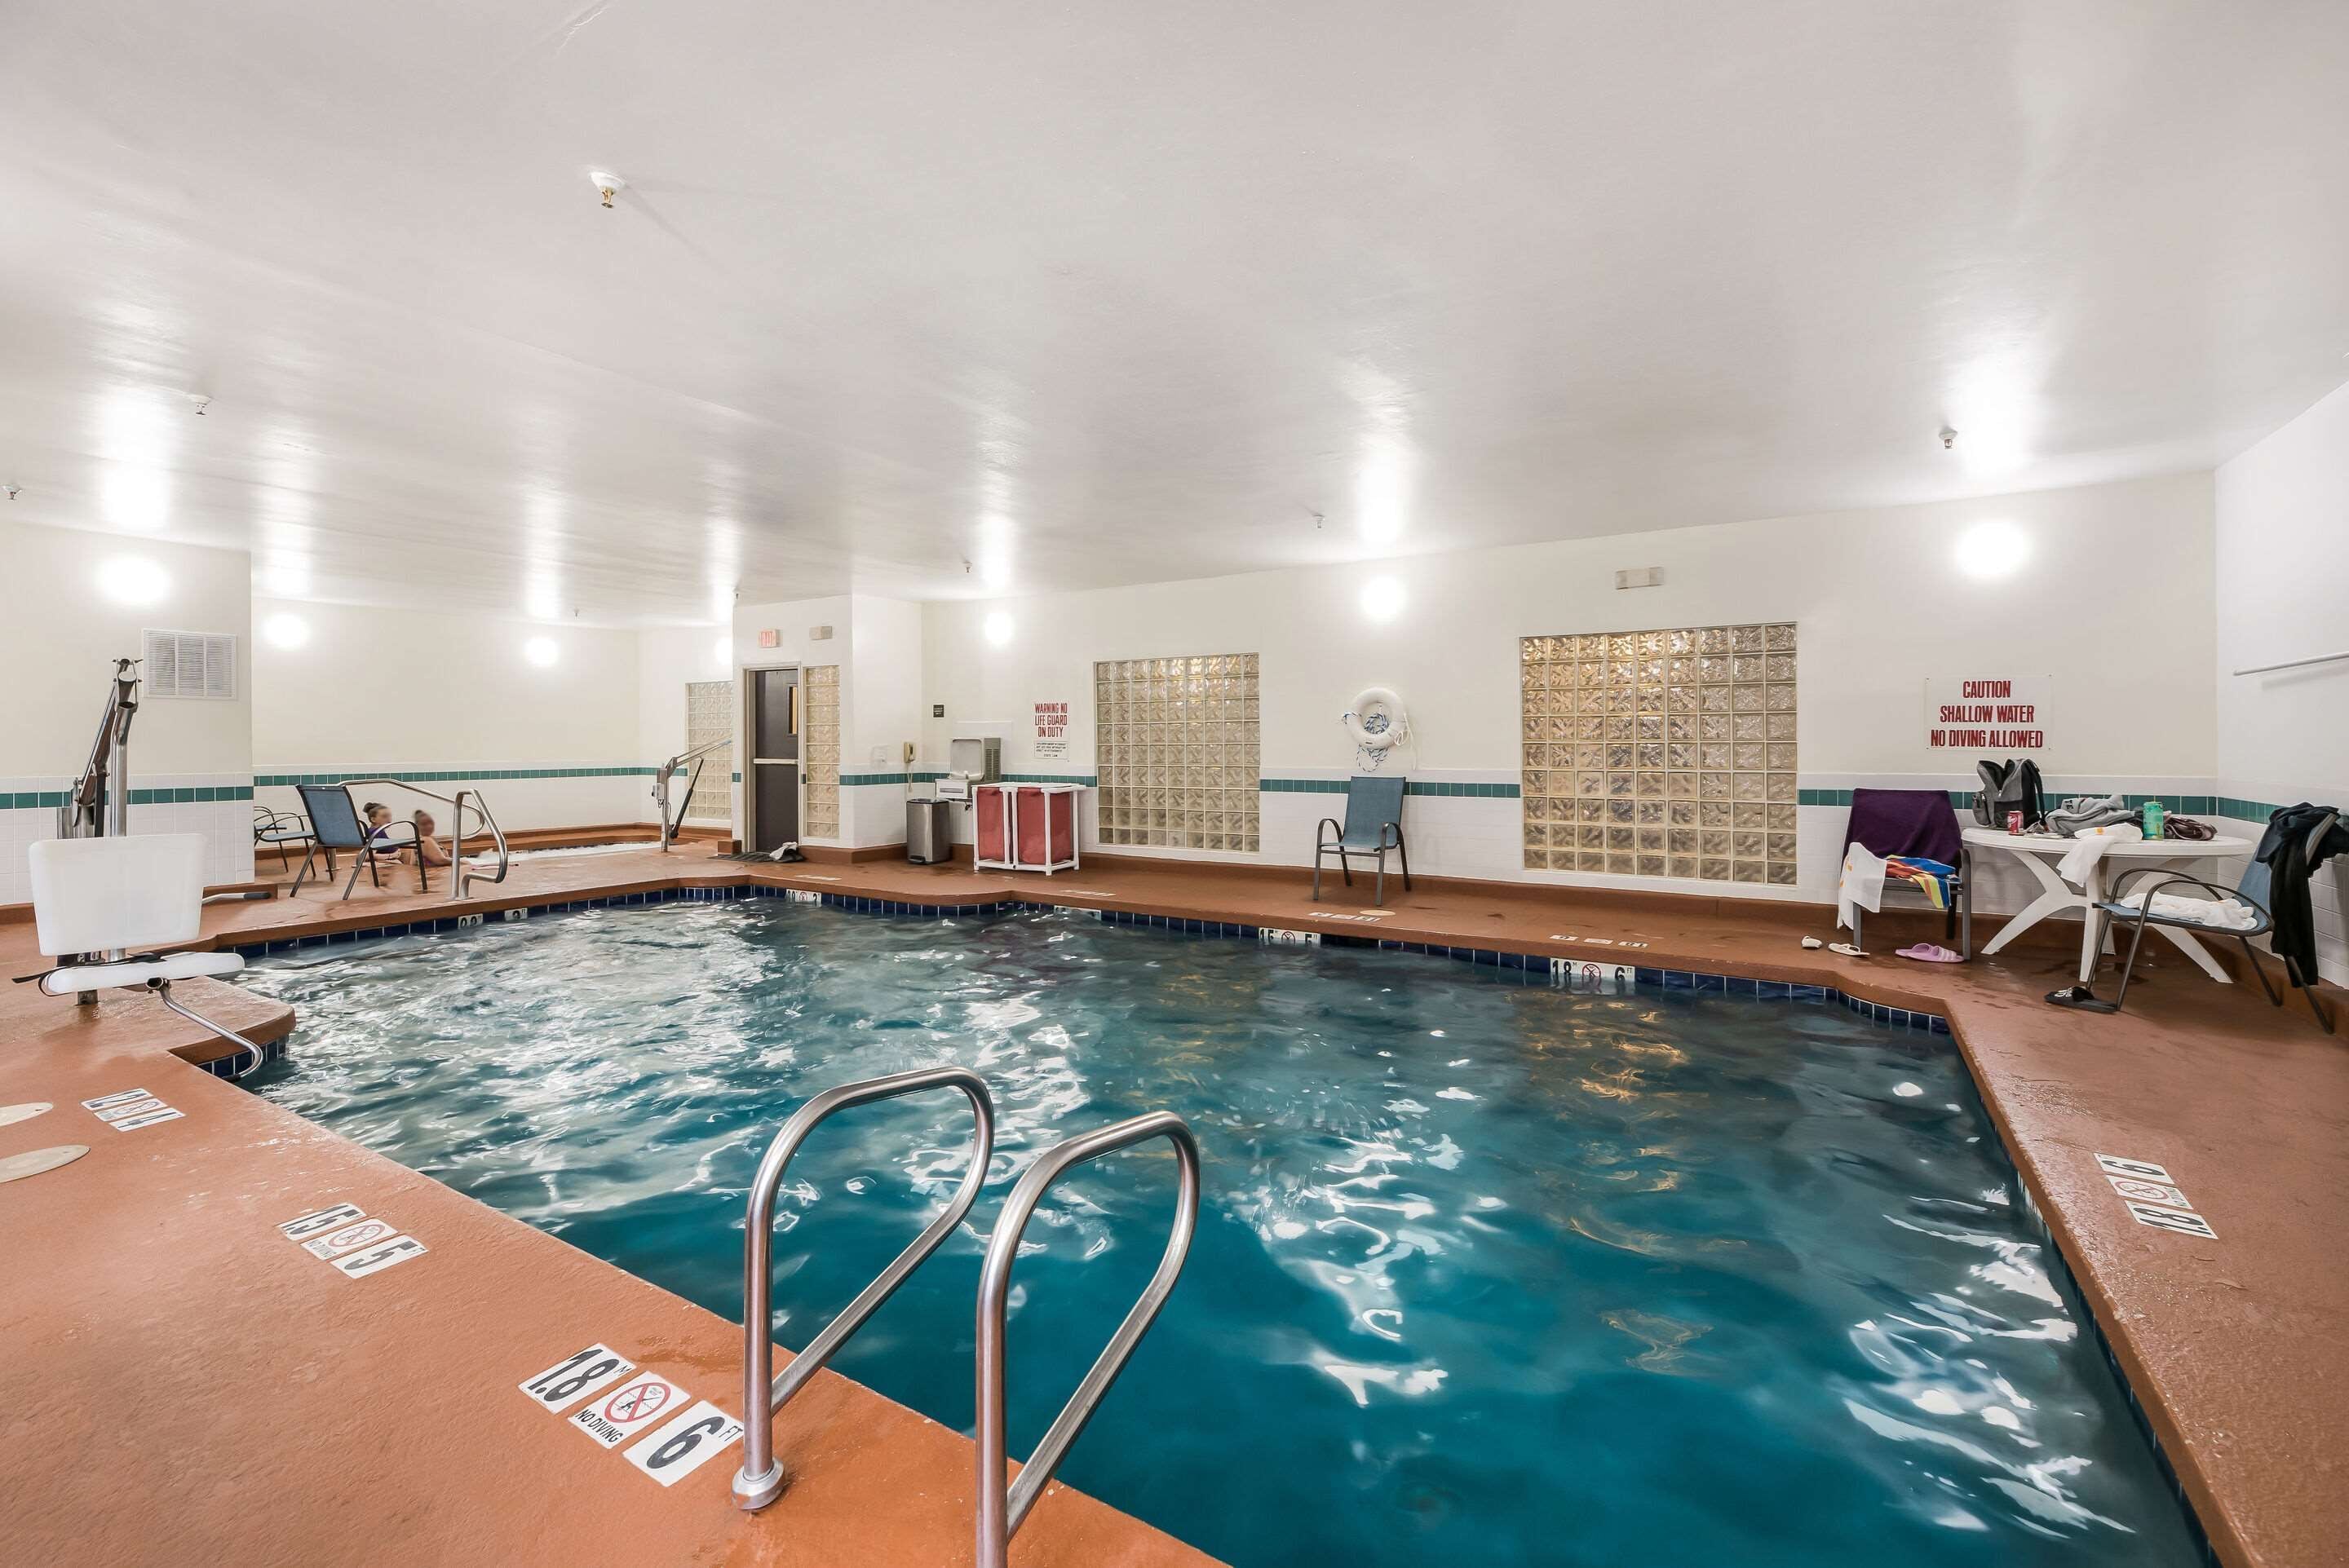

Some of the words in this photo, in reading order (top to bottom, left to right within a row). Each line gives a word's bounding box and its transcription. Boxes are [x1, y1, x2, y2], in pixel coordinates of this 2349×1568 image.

[1962, 681, 2011, 699] CAUTION
[1034, 703, 1059, 714] WARNING
[1060, 703, 1068, 714] NO
[1940, 705, 1993, 723] SHALLOW
[1997, 705, 2035, 723] WATER
[1034, 714, 1046, 726] LIFE
[1046, 715, 1068, 726] GUARD
[1037, 727, 1046, 737] ON
[1047, 727, 1064, 737] DUTY
[1931, 730, 1946, 747] NO
[1949, 730, 1986, 748] DIVING
[1988, 731, 2043, 748] ALLOWED
[2101, 1159, 2165, 1176] 6
[343, 1240, 418, 1270] 5
[527, 1348, 620, 1402] 1.8
[575, 1408, 593, 1424] NO
[591, 1416, 624, 1442] DIVING
[646, 1416, 726, 1469] 6
[719, 1424, 744, 1442] FT
